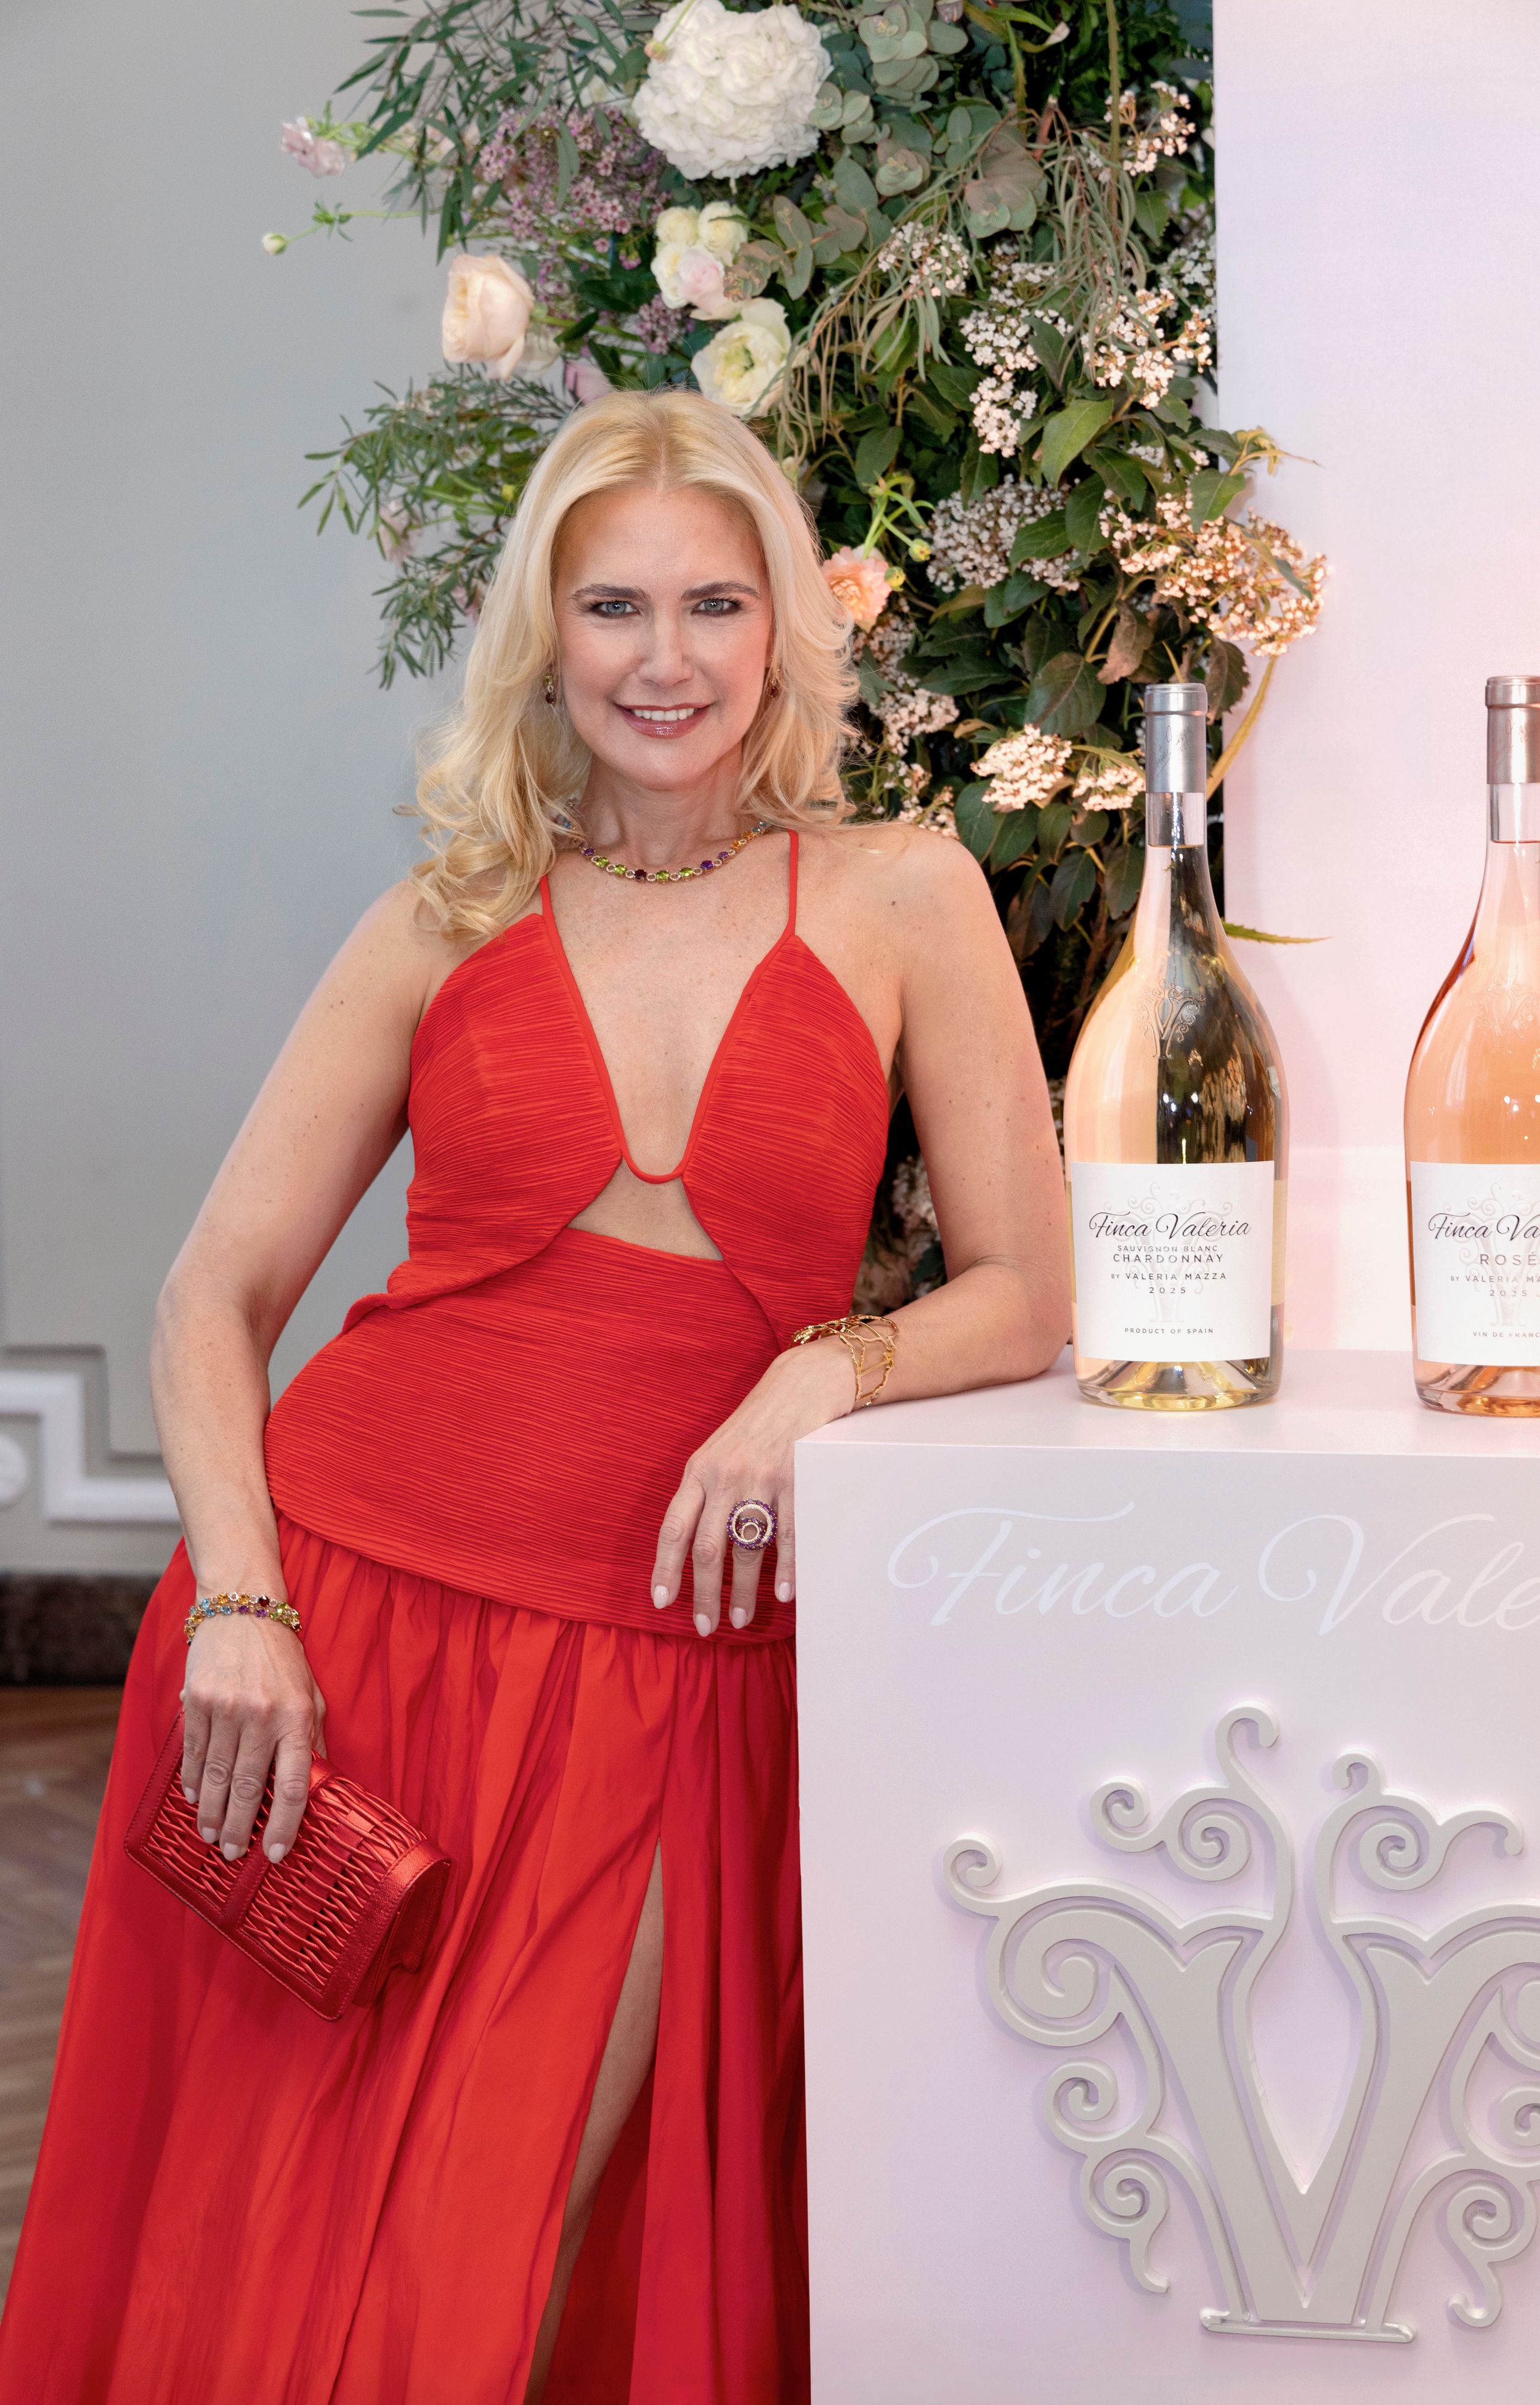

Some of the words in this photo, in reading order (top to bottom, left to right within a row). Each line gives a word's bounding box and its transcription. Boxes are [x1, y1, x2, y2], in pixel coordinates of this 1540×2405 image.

[1089, 1211, 1151, 1238] Finca
[1156, 1212, 1252, 1239] Valeria
[1428, 1212, 1492, 1239] Finca
[1496, 1214, 1540, 1241] Va
[1113, 1254, 1223, 1263] CHARDONNAY
[1480, 1251, 1537, 1265] ROSÉ
[888, 1501, 1238, 1626] Finca
[1258, 1513, 1540, 1636] Vale
